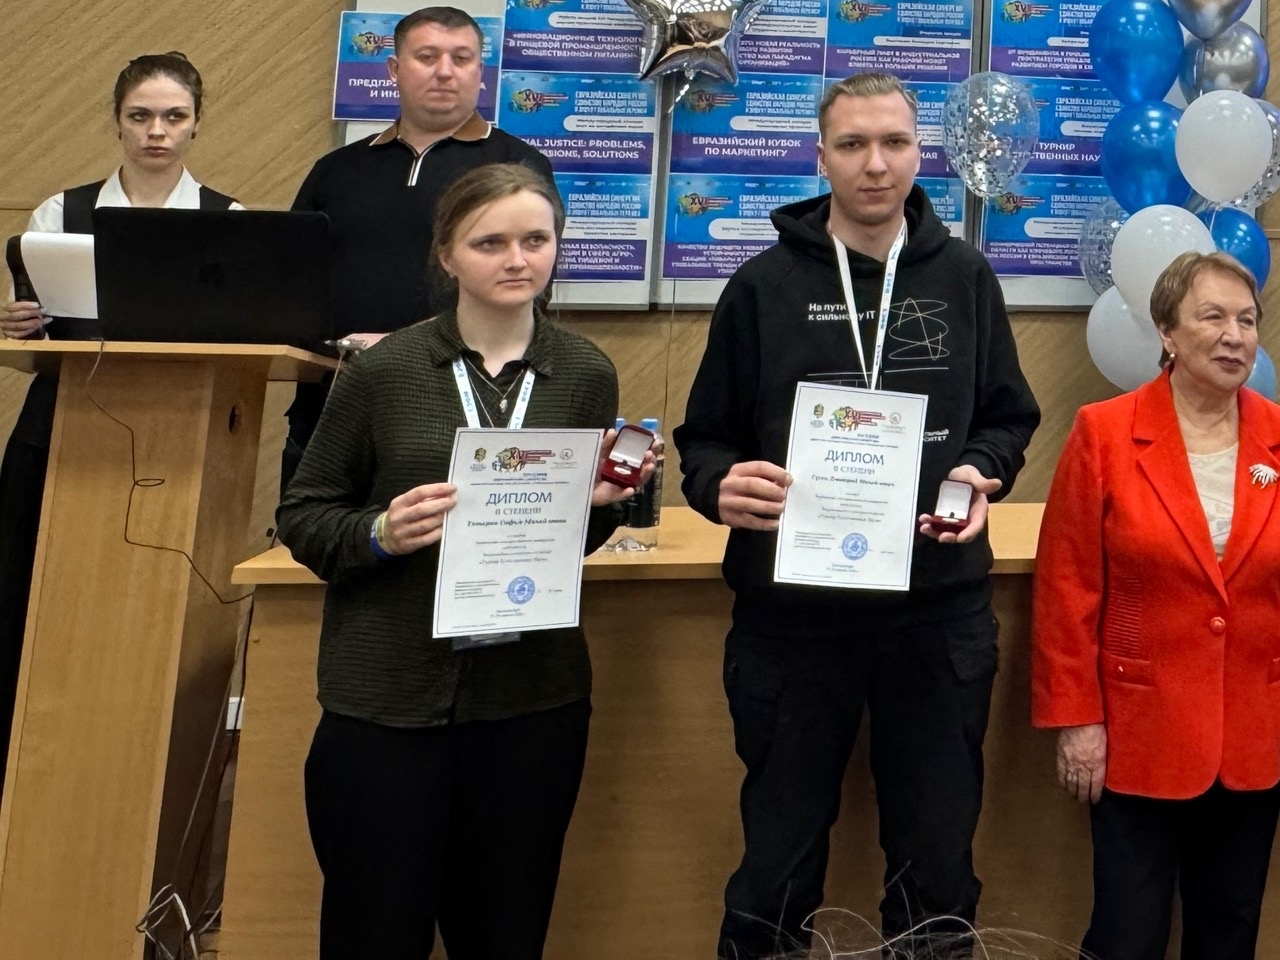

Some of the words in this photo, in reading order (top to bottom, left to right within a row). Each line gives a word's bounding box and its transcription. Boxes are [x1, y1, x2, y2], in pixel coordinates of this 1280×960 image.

[562, 42, 641, 50] ПРОМЫШЛЕННОСТ
[589, 140, 645, 149] PROBLEMS,
[693, 136, 766, 146] ЕВРАЗИЙСКИЙ
[1039, 142, 1075, 150] ТУРНИР
[583, 151, 638, 159] SOLUTIONS
[809, 303, 822, 311] На
[816, 313, 864, 321] сильноу
[866, 311, 875, 319] IT
[825, 449, 884, 466] ДИПЛОМ
[486, 492, 552, 506] ДИПЛОМ
